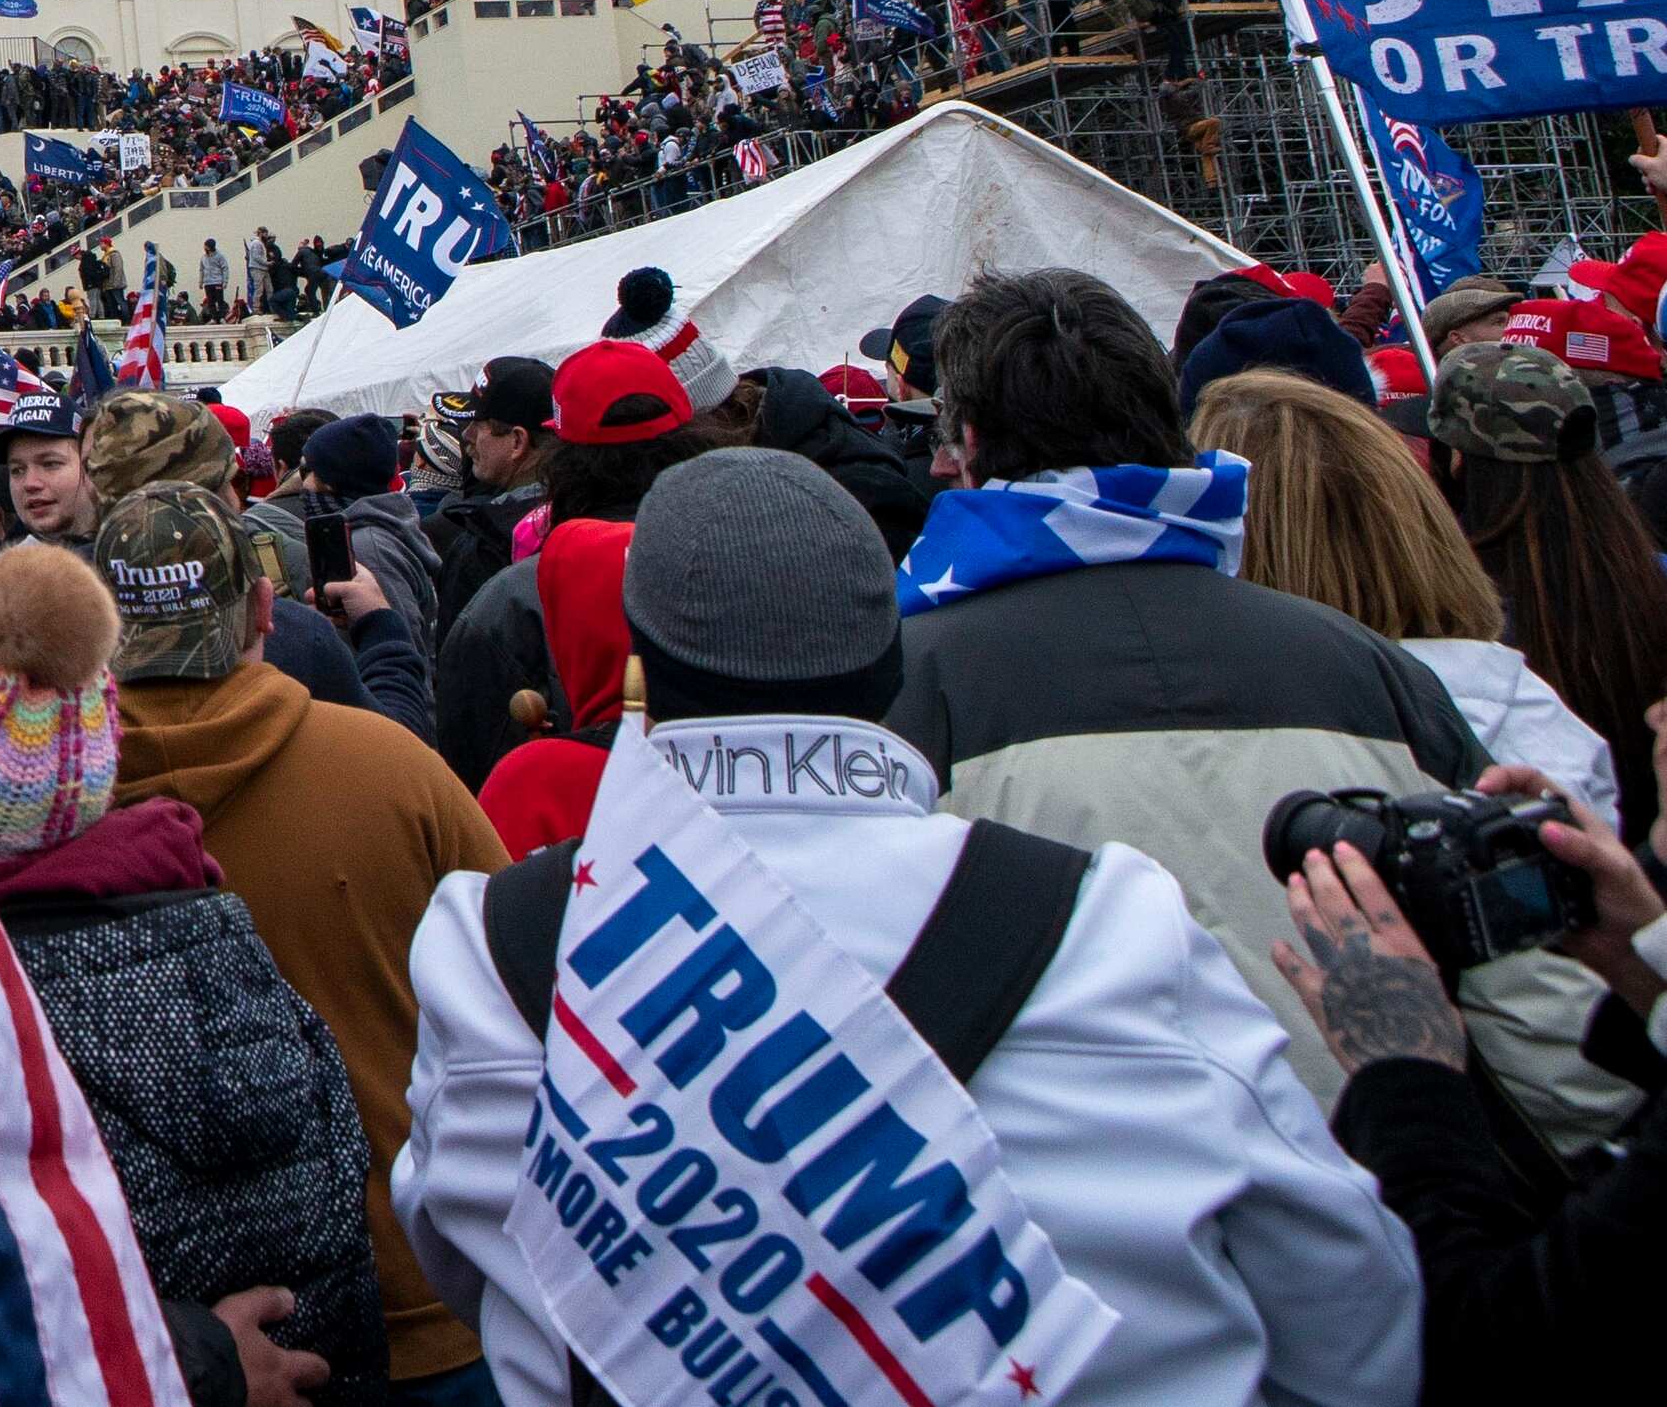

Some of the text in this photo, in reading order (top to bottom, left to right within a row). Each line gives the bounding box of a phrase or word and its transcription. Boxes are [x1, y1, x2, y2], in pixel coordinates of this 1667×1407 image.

[1369, 33, 1506, 95] OR
[233, 88, 281, 113] TRUMP
[33, 161, 84, 182] LIBERTY
[379, 161, 483, 278] TRU
[109, 558, 205, 590] Trump
[786, 732, 909, 801] Klein
[567, 844, 1030, 1347] TRUMP
[527, 1133, 655, 1287] MORE
[585, 1102, 805, 1315] 2020
